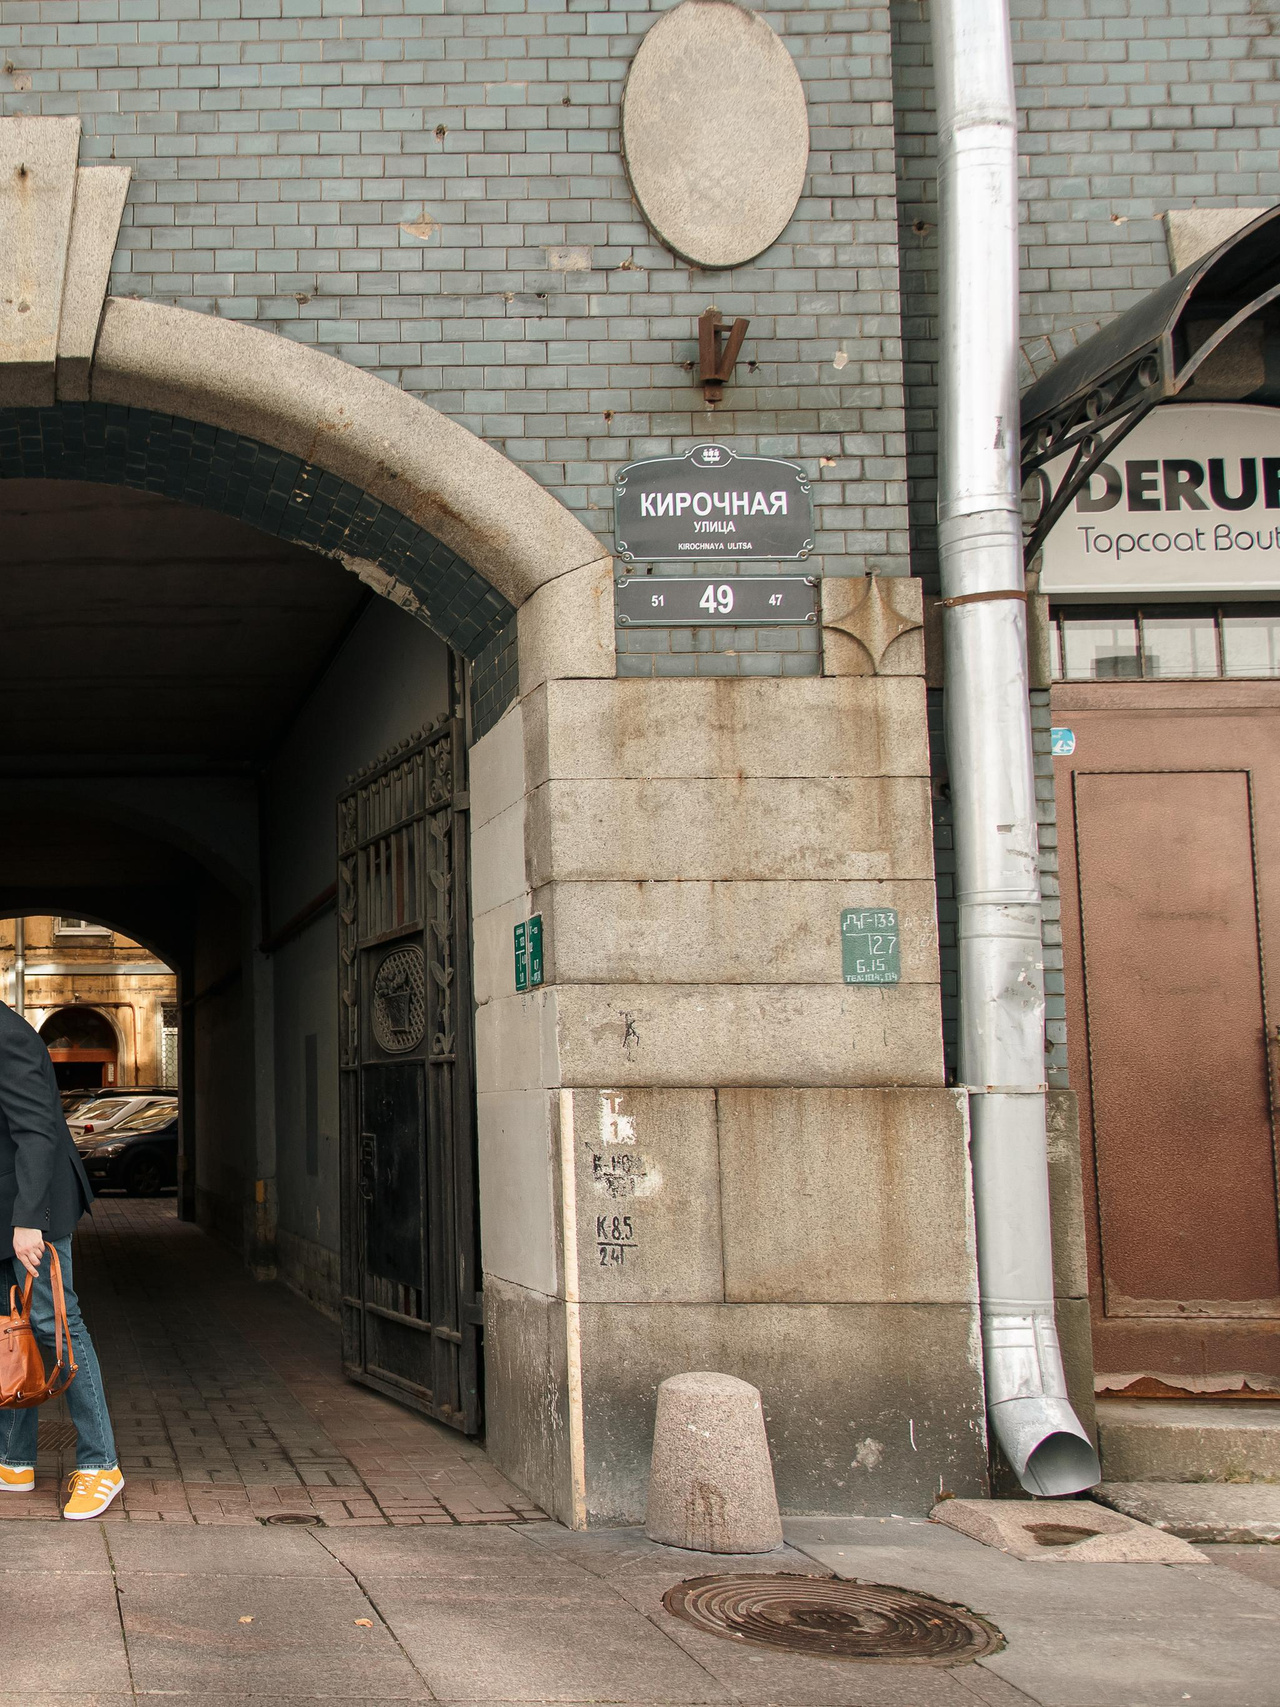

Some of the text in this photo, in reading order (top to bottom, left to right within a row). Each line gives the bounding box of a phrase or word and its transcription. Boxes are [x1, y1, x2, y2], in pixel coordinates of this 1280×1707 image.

[640, 491, 788, 517] КИРОЧНАЯ
[693, 521, 736, 534] УЛИЦА
[678, 541, 753, 550] KIROCHNAYA ULITSA
[1077, 526, 1207, 560] Topcoat
[651, 584, 783, 614] 51 49 47
